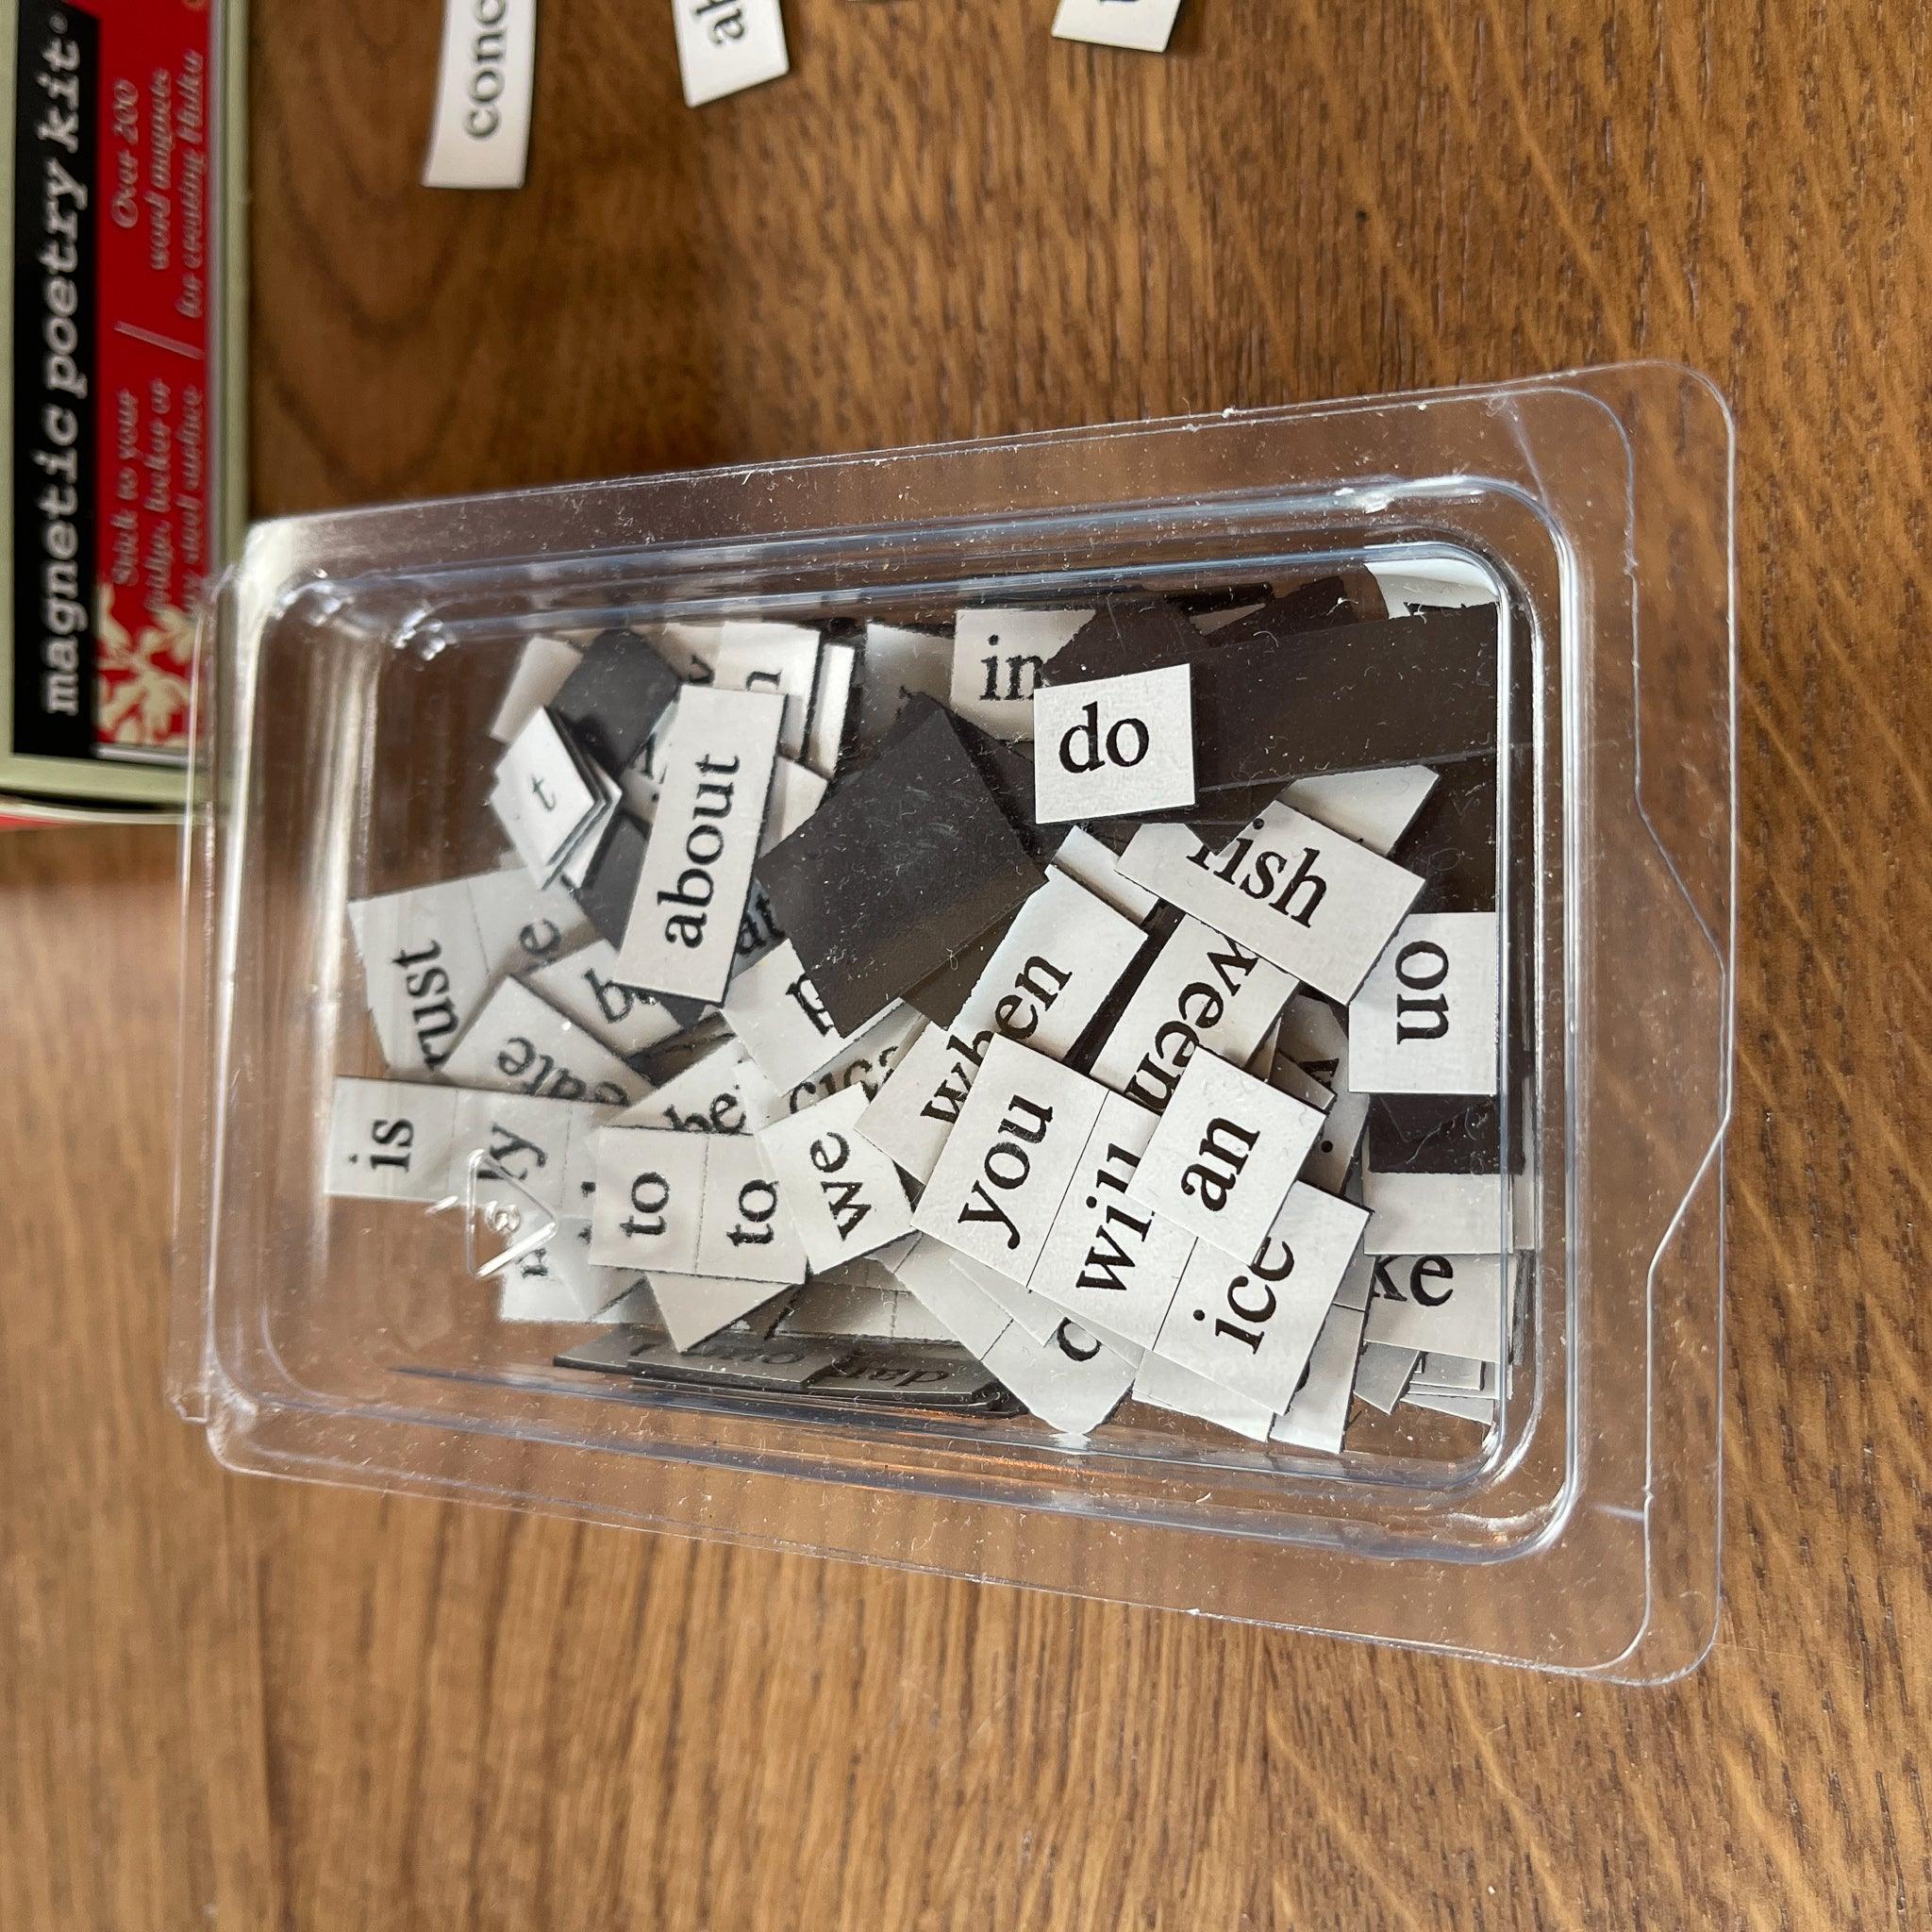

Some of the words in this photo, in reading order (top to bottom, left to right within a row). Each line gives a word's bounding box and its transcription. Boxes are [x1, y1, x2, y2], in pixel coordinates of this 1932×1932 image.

[40, 158, 89, 398] poetry
[31, 405, 87, 716] magnetic
[979, 634, 1044, 702] in
[1058, 701, 1151, 774] do
[658, 754, 741, 948] about
[1187, 817, 1327, 928] ish
[919, 955, 1073, 1125] when
[1394, 941, 1451, 1045] on
[347, 1117, 415, 1174] is
[808, 1130, 874, 1242] we
[957, 1094, 1055, 1251] you
[1180, 1116, 1262, 1213] an
[619, 1171, 671, 1239] to
[725, 1178, 780, 1248] to
[1191, 1236, 1295, 1356] ice
